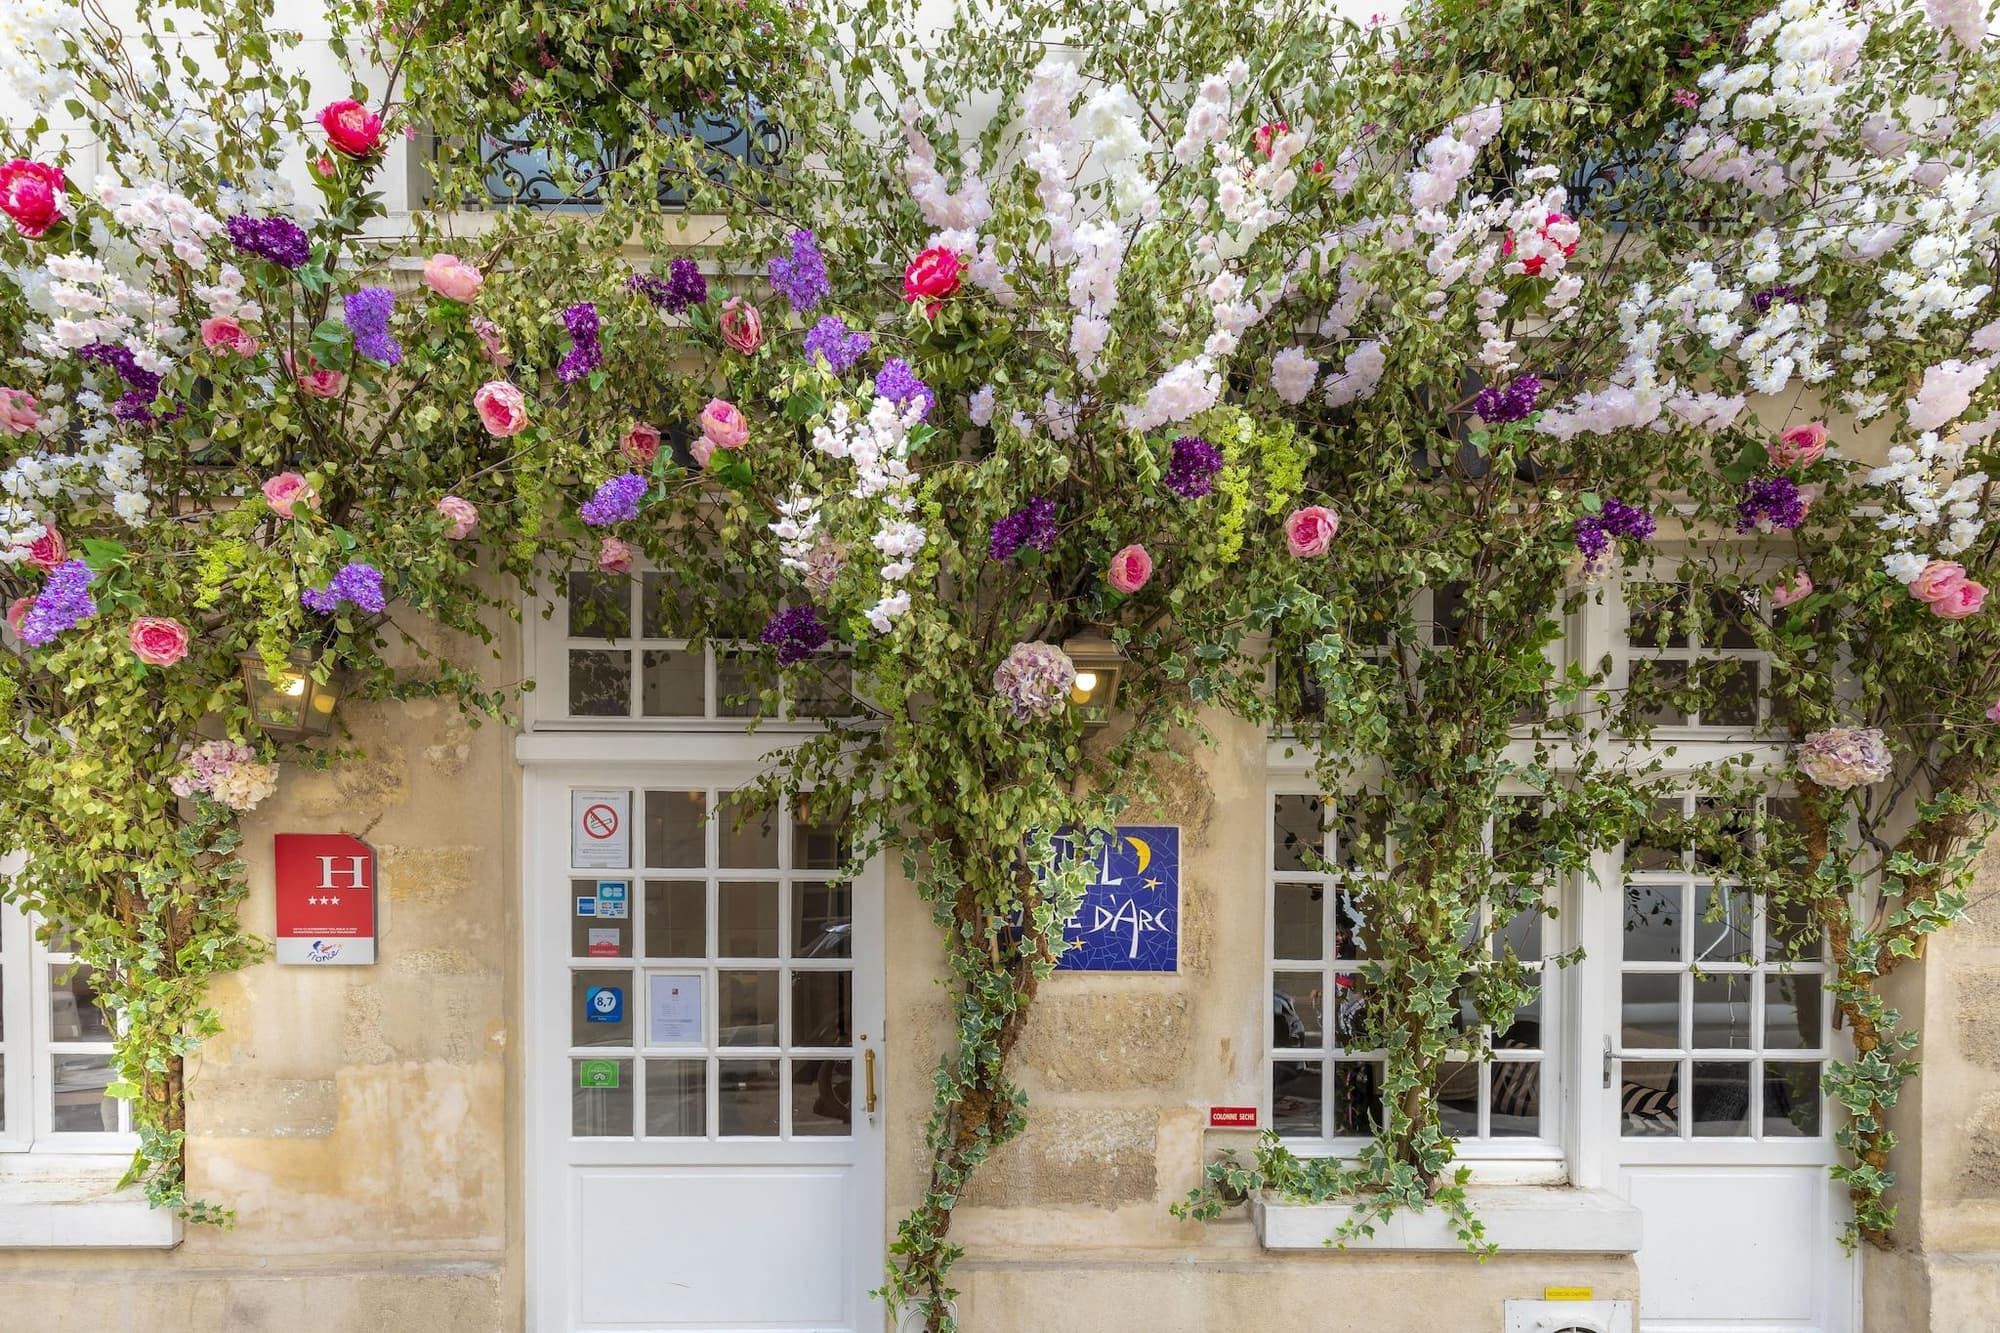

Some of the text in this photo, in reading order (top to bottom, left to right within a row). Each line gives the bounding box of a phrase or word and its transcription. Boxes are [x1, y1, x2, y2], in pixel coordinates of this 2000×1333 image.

[315, 855, 370, 889] H
[596, 996, 614, 1008] 8,7
[1212, 1112, 1238, 1121] COLONNE
